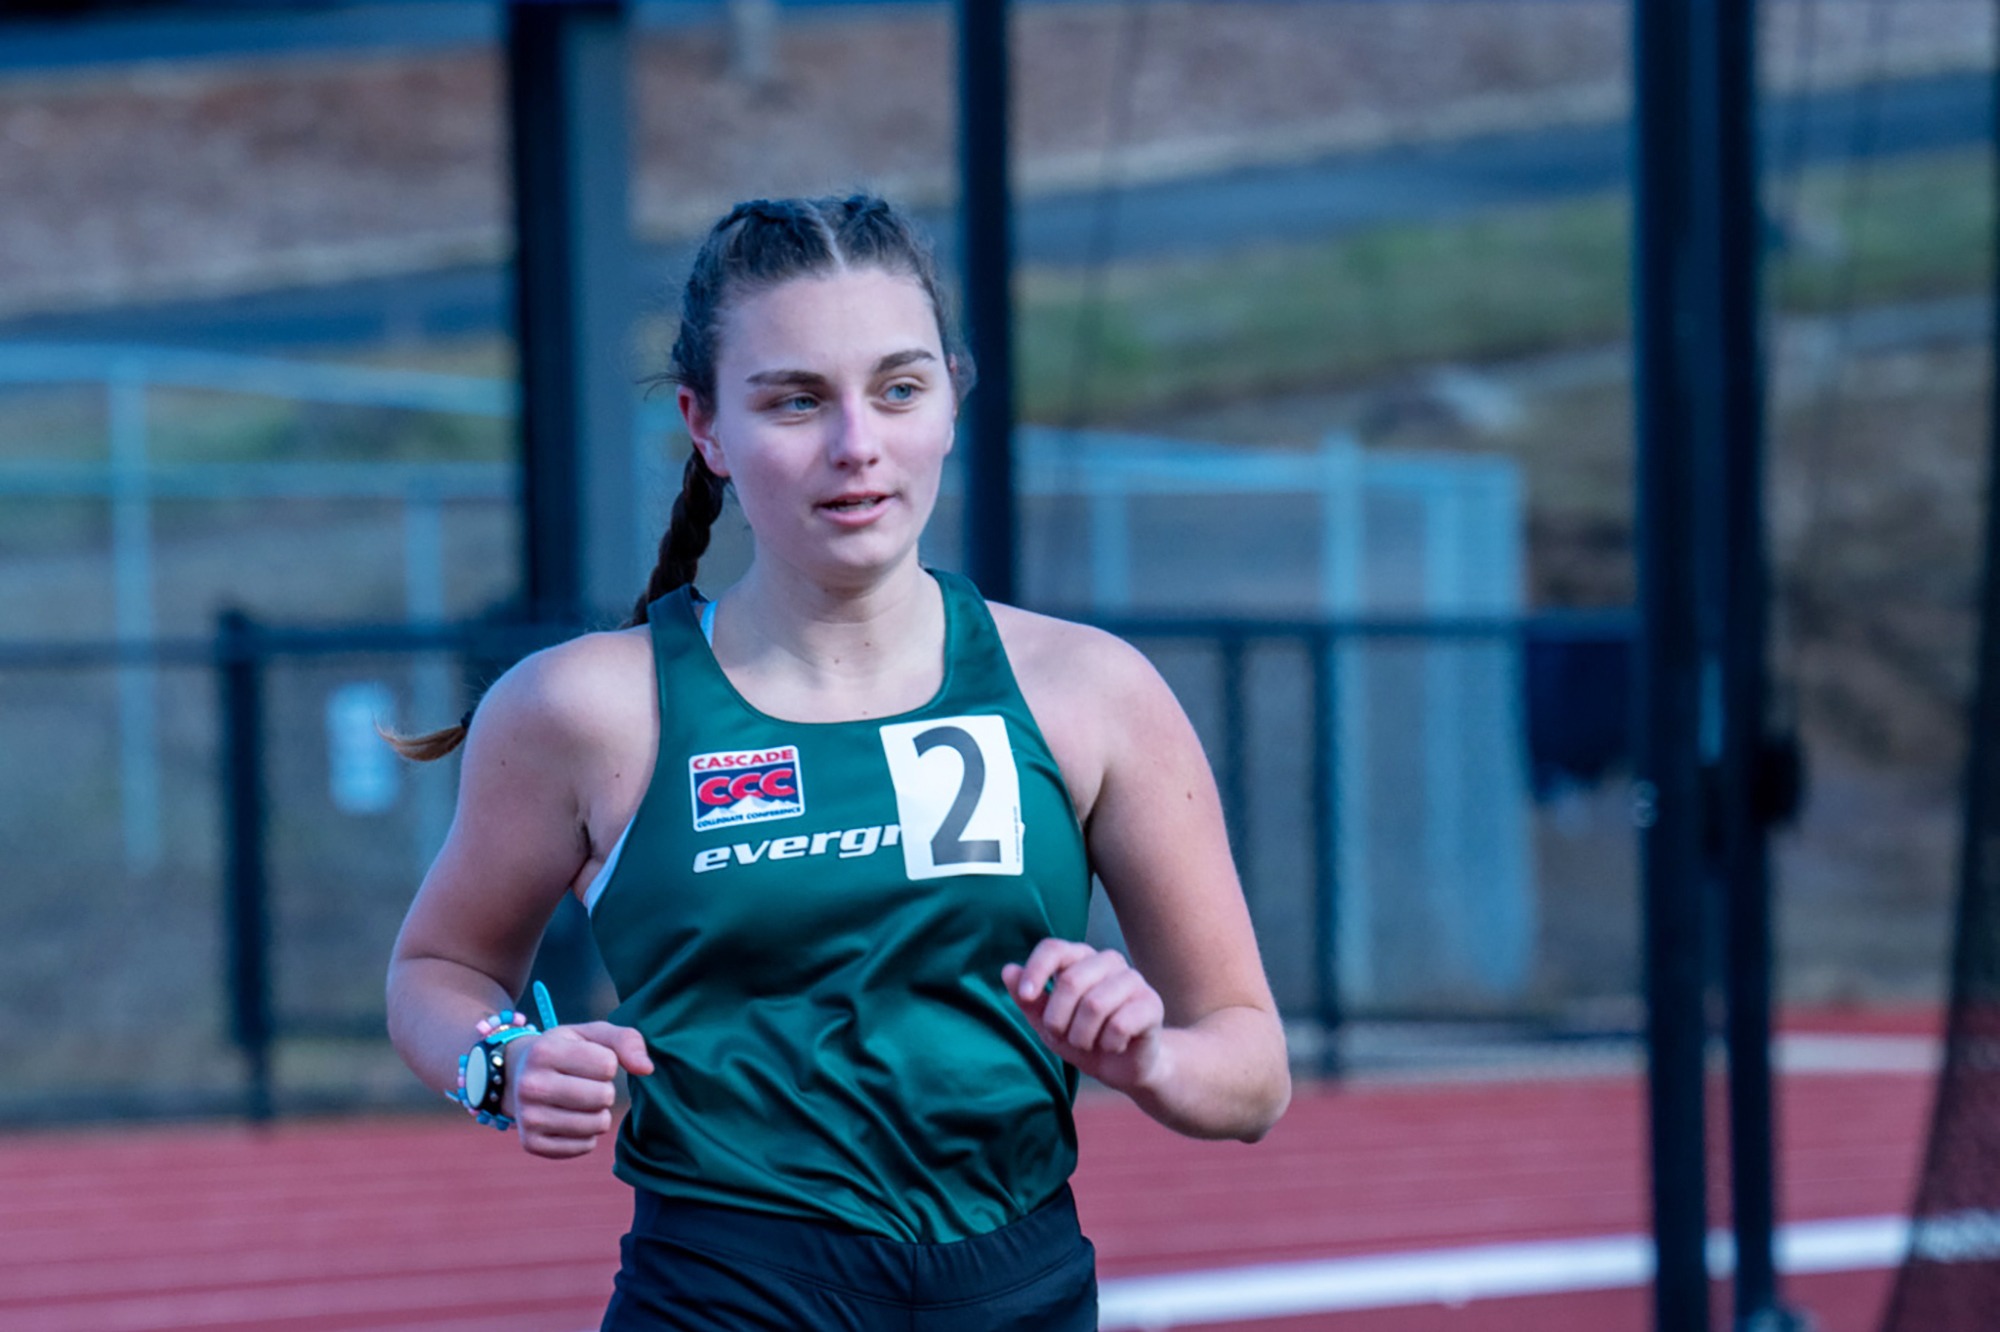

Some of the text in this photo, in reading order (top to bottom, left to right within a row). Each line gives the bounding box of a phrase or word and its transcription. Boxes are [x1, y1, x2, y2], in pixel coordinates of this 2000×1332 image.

[693, 749, 794, 770] CASCADE
[697, 768, 796, 806] CCC
[912, 725, 1001, 866] 2
[746, 806, 801, 820] CONFERENCE
[693, 823, 901, 873] evergr
